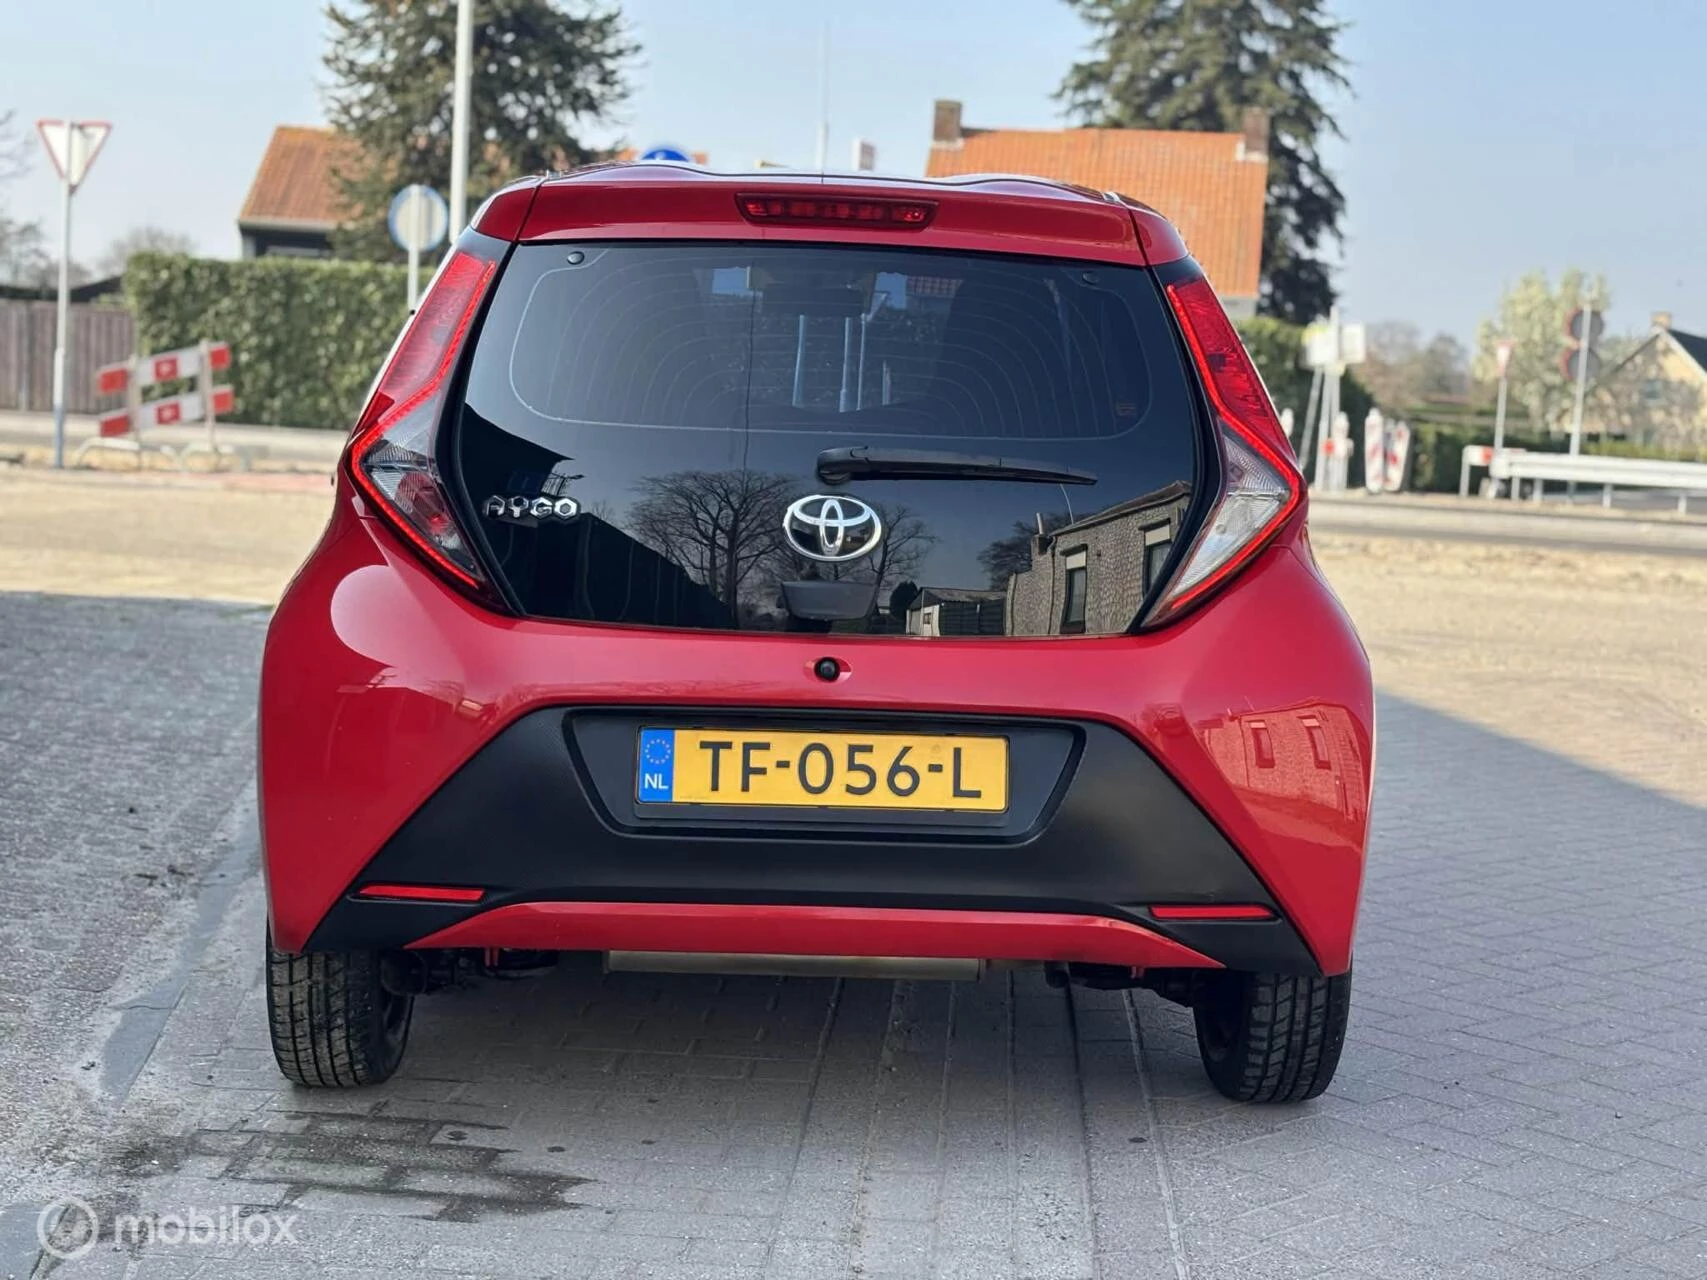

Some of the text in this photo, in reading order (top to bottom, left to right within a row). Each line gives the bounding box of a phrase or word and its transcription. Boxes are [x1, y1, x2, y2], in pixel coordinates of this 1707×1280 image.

[485, 495, 579, 520] AYGO
[644, 773, 669, 790] NL
[699, 741, 982, 799] TF-056-L
